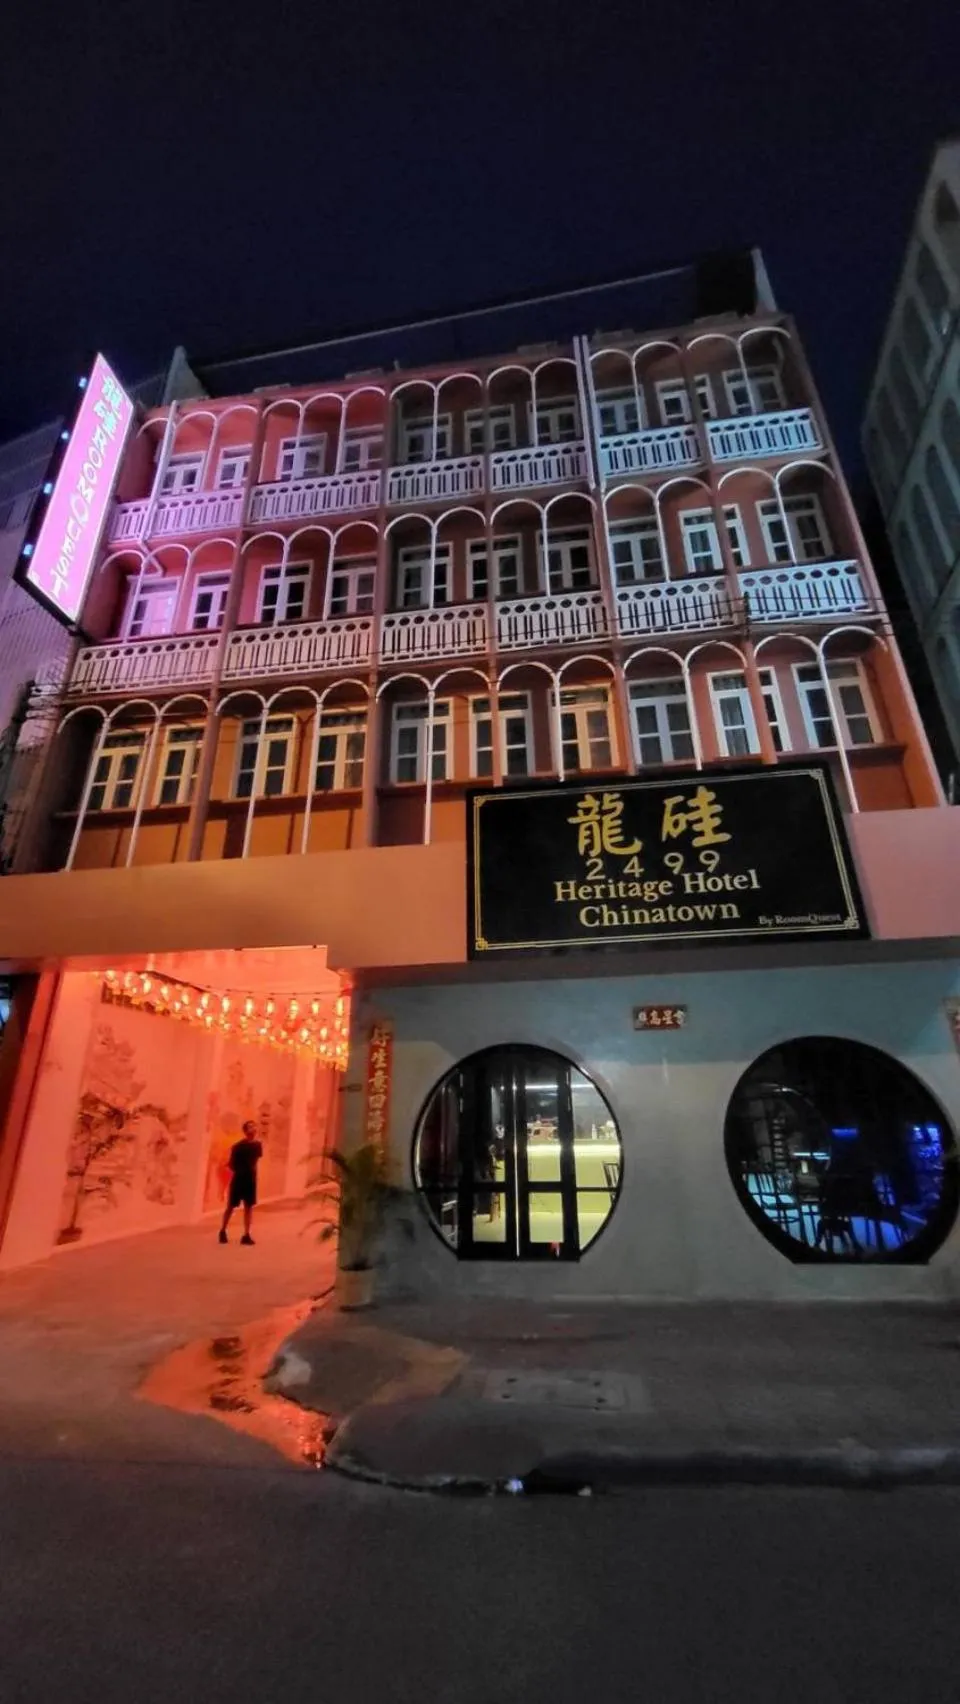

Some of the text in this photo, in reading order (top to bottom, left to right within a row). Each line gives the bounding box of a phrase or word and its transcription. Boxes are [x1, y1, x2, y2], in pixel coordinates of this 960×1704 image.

[554, 869, 761, 902] Heritage Hotel
[579, 902, 741, 928] Chinatown
